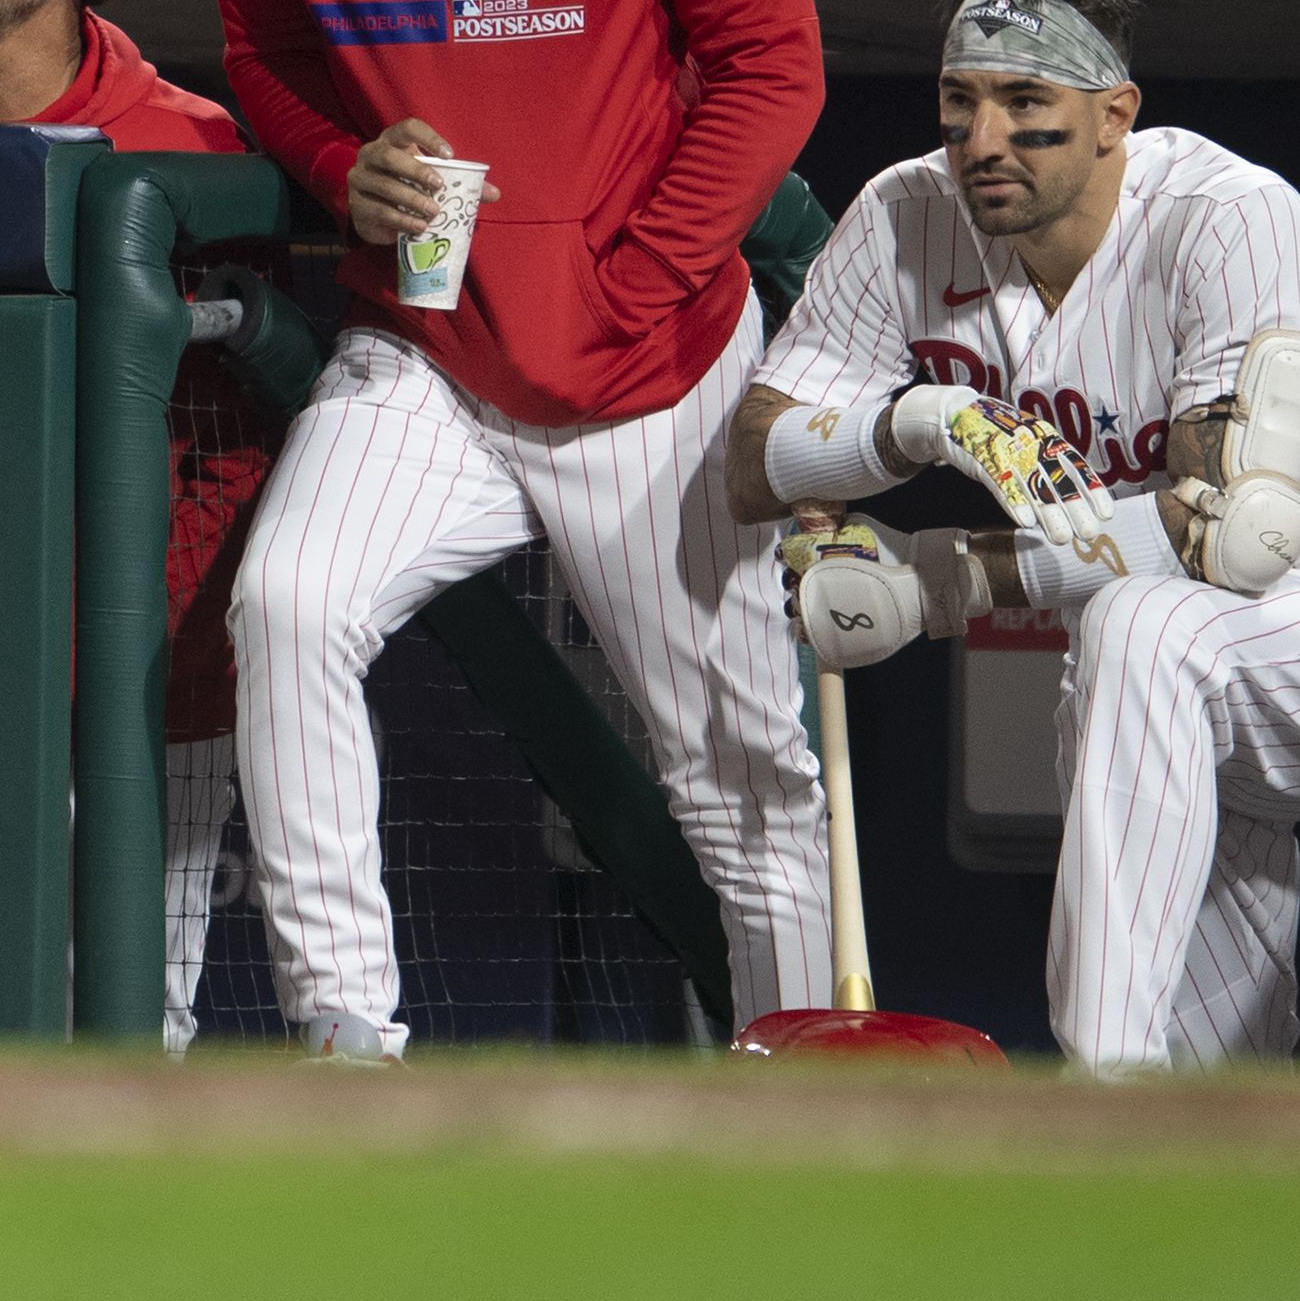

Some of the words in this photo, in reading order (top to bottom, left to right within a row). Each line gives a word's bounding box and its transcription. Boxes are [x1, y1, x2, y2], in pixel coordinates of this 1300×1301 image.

[320, 13, 438, 32] PHILADELPHIA
[482, 0, 528, 13] 2023
[453, 10, 585, 38] POSTSEASON
[829, 608, 875, 632] 8
